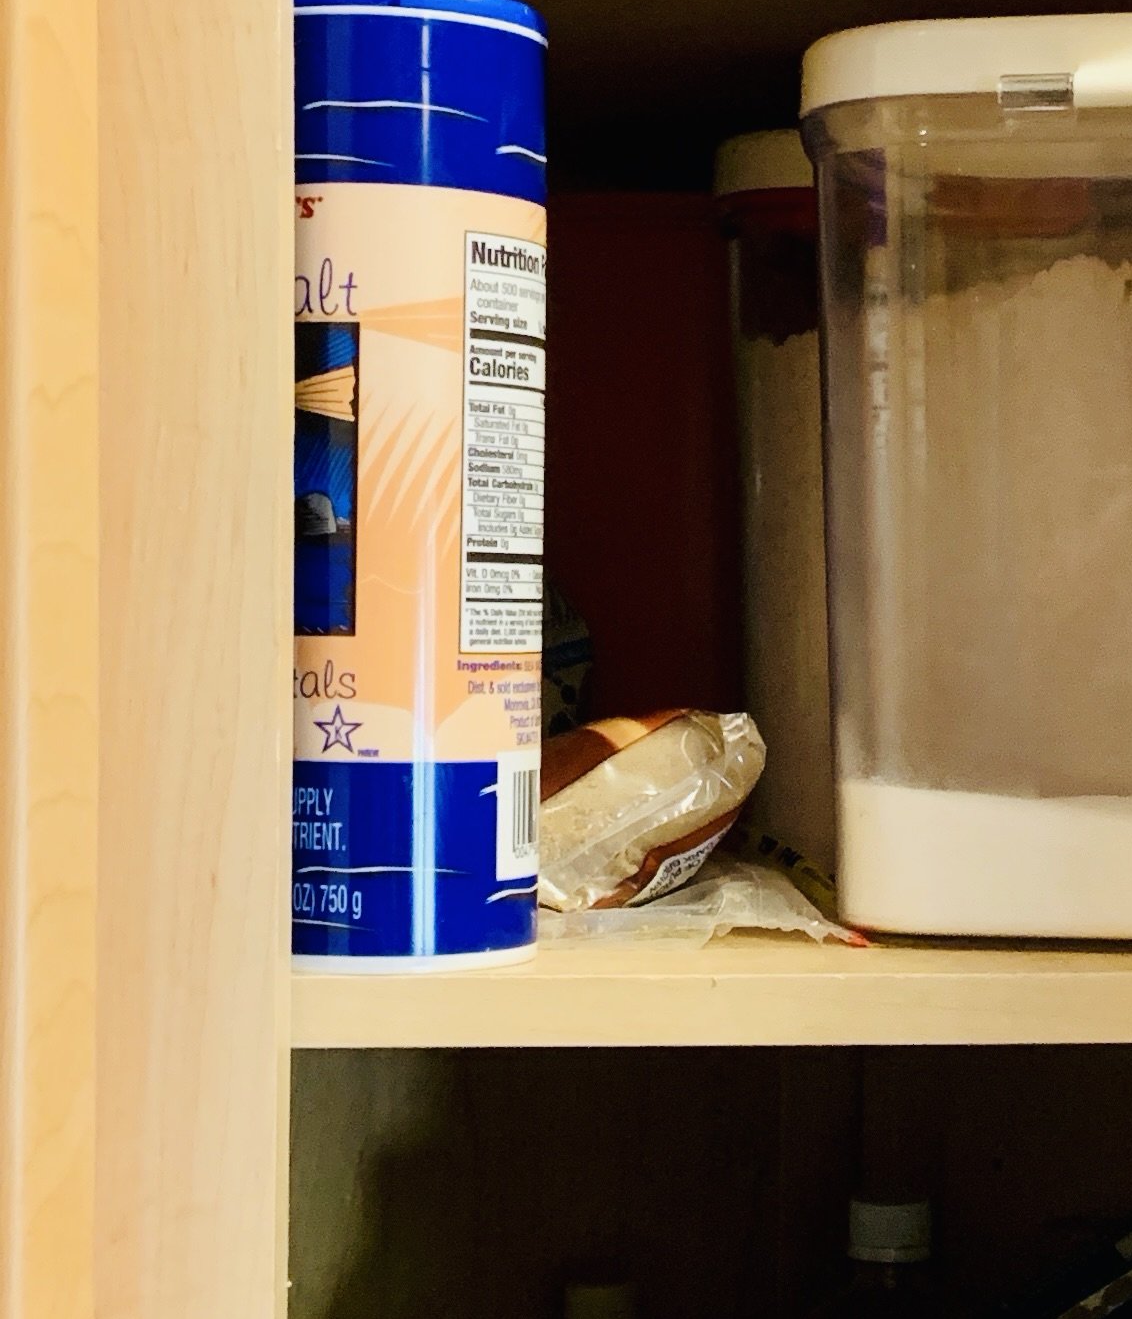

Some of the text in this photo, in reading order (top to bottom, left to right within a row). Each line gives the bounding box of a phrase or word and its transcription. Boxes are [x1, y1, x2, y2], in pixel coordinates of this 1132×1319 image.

[470, 311, 510, 331] Serving
[470, 356, 530, 382] Calories
[320, 881, 349, 916] 750
[352, 889, 362, 921] g
